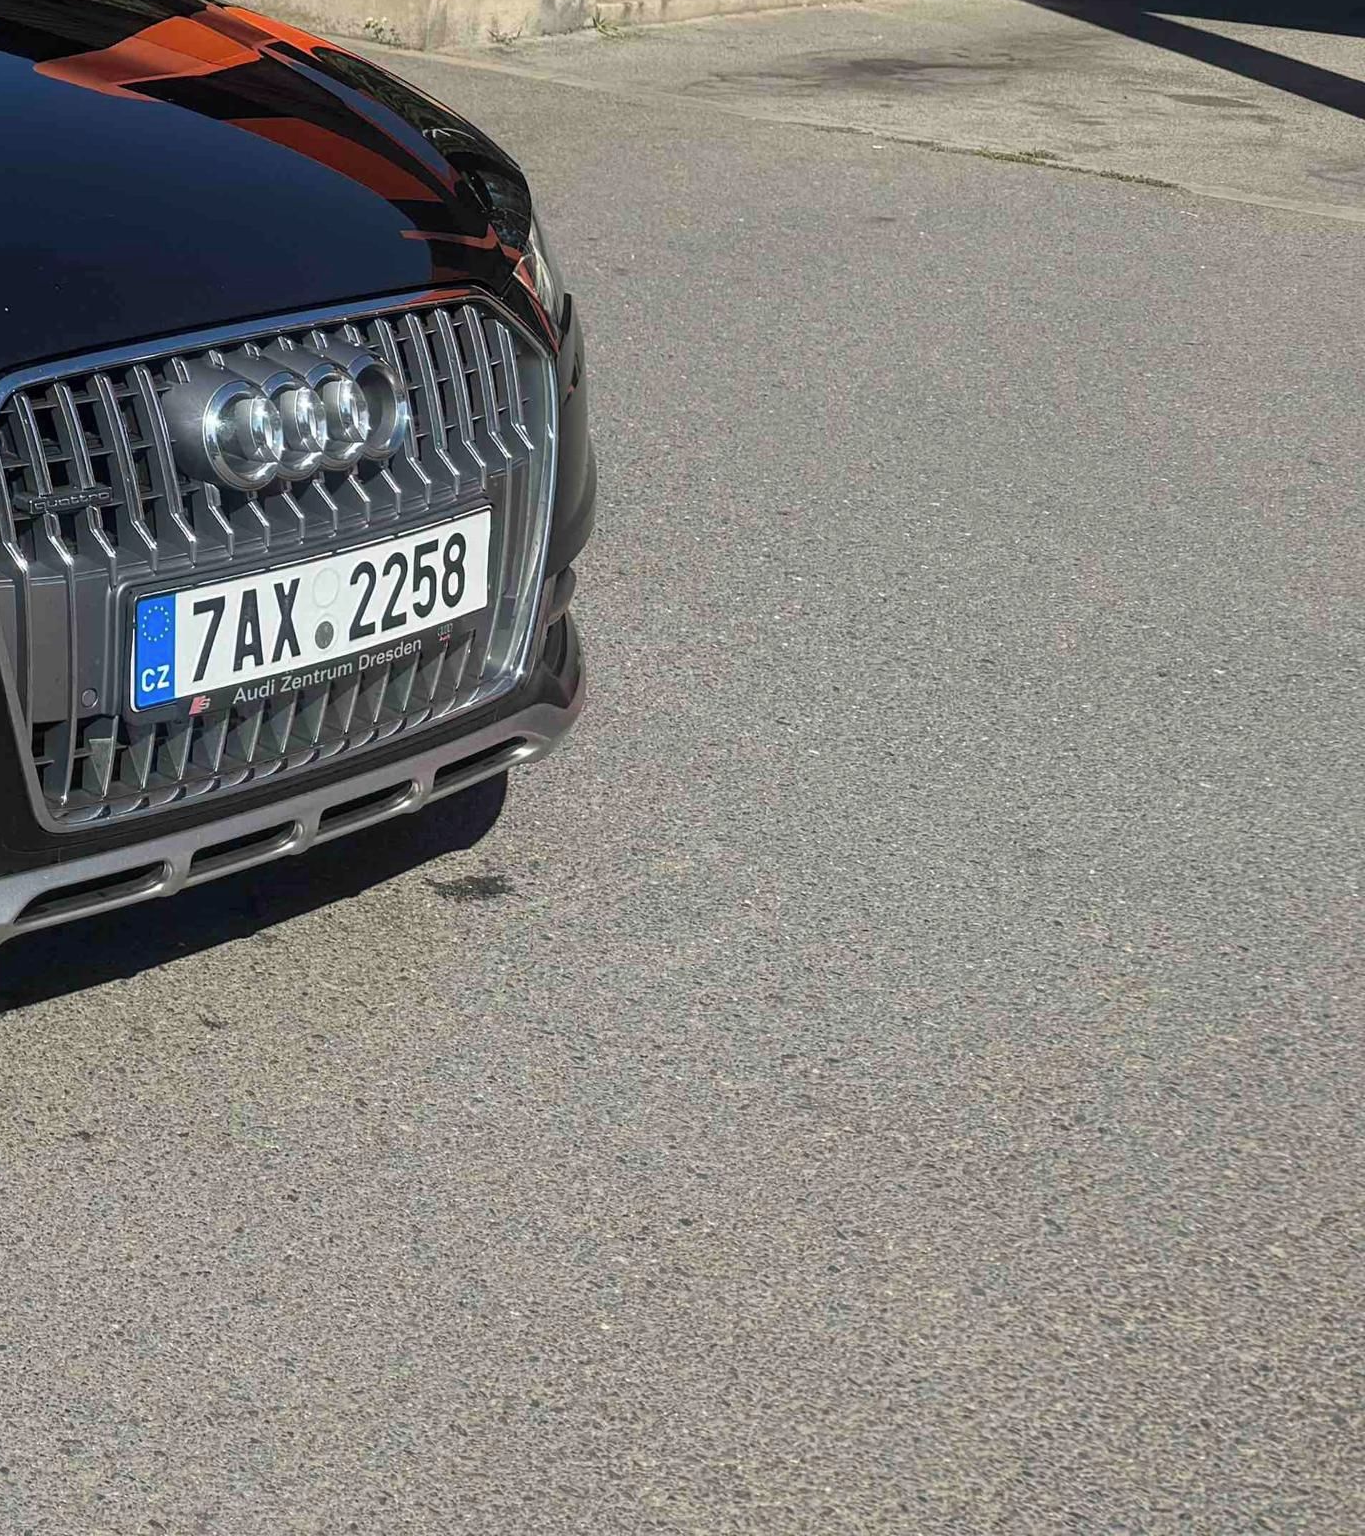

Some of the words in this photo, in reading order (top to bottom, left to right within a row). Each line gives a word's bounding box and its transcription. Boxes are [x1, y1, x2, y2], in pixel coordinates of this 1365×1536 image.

[192, 577, 302, 683] 7AX
[348, 532, 467, 642] 2258
[141, 664, 170, 693] CZ
[232, 679, 275, 705] Audi
[280, 664, 353, 693] Zentrum
[358, 639, 422, 671] Dresden
